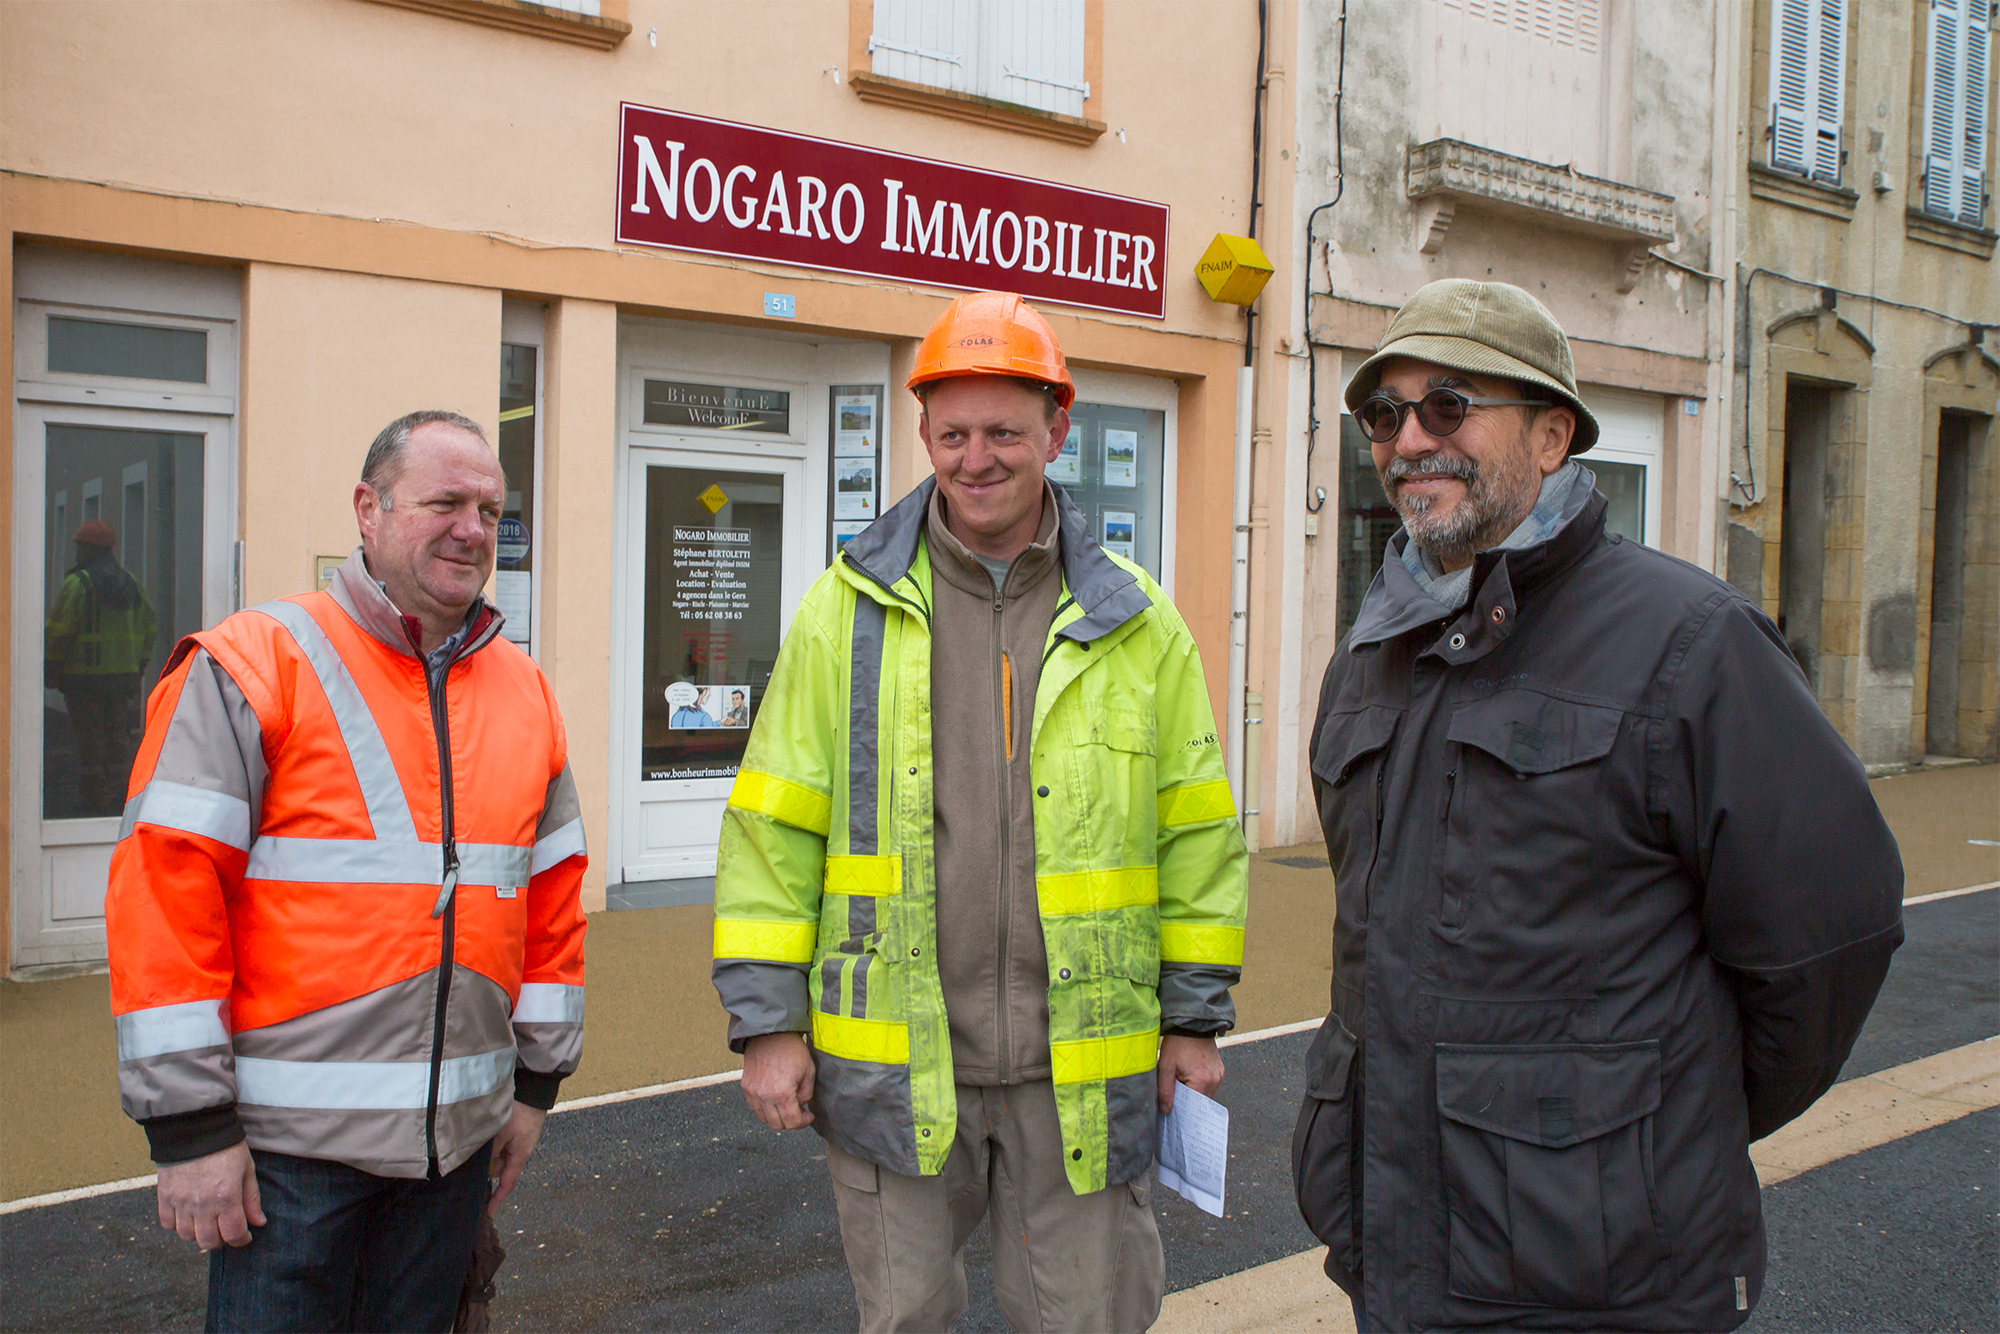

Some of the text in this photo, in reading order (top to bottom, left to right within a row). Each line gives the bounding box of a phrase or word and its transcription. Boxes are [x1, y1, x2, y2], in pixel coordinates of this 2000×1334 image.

[631, 134, 1158, 291] NOGARO IMMOBILIER
[1201, 260, 1232, 273] FNAIM
[772, 297, 787, 312] 51
[960, 337, 993, 346] COLAS
[498, 524, 520, 536] 2018
[675, 529, 749, 542] NOGARO IMMOBILIER
[673, 548, 750, 559] Stéphane BERTOLETTI
[689, 569, 709, 578] Achat
[714, 570, 735, 579] Vente
[676, 579, 706, 588] Location
[711, 579, 747, 589] Evaluation
[682, 593, 707, 601] agences
[708, 591, 723, 599] dans
[724, 591, 731, 599] le
[731, 592, 746, 600] Gers
[680, 611, 690, 619] Tél
[694, 611, 704, 619] 05
[704, 611, 714, 619] 62
[714, 611, 723, 619] 08
[724, 611, 733, 620] 38
[733, 611, 743, 620] 63
